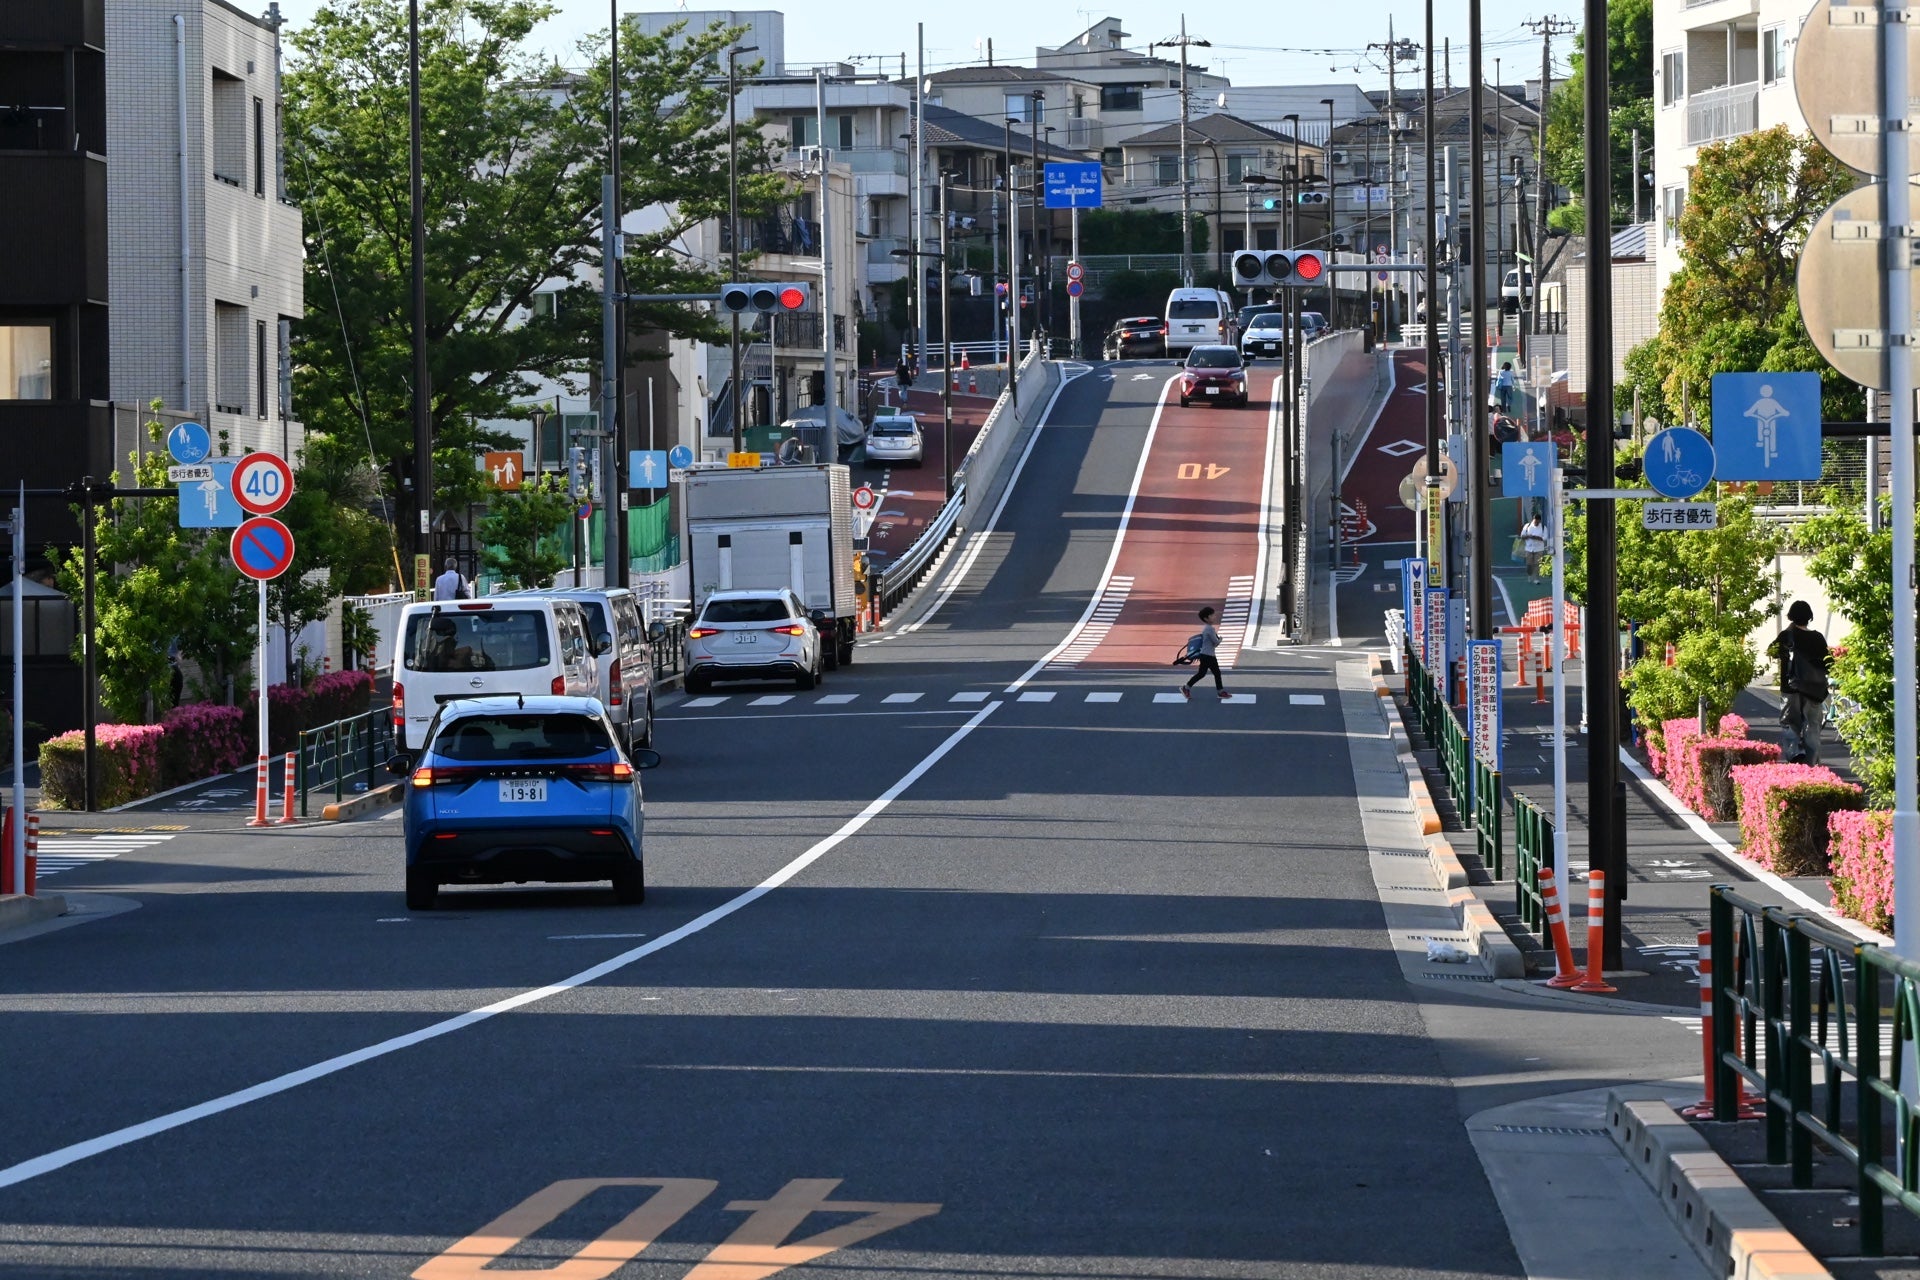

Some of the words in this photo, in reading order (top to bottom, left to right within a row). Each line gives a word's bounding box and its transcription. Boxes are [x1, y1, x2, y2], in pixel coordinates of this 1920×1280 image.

[171, 468, 210, 479] 歩行者優先
[1177, 463, 1231, 479] 40
[246, 470, 279, 496] 40
[1647, 508, 1712, 524] 歩行者優先
[1413, 581, 1423, 640] 自転車逆走禁止
[511, 788, 542, 800] 19-81
[410, 1177, 942, 1280] 40
